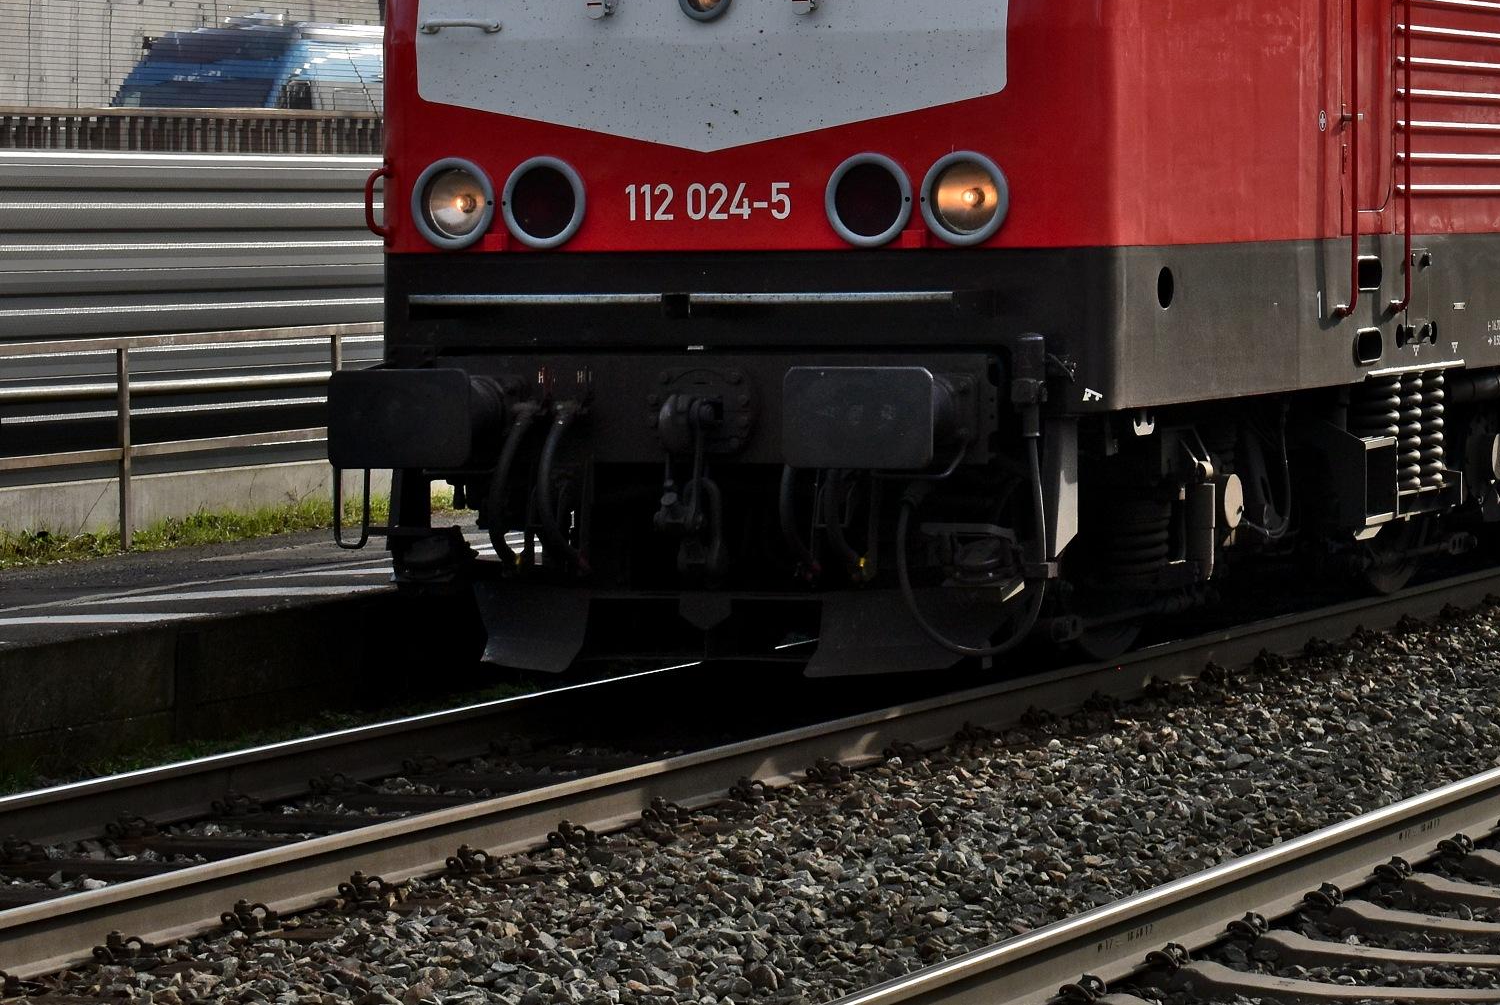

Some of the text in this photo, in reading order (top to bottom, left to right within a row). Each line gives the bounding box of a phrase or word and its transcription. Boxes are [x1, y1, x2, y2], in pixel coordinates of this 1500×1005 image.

[625, 182, 791, 221] 112 024-5
[1316, 290, 1322, 319] 1
